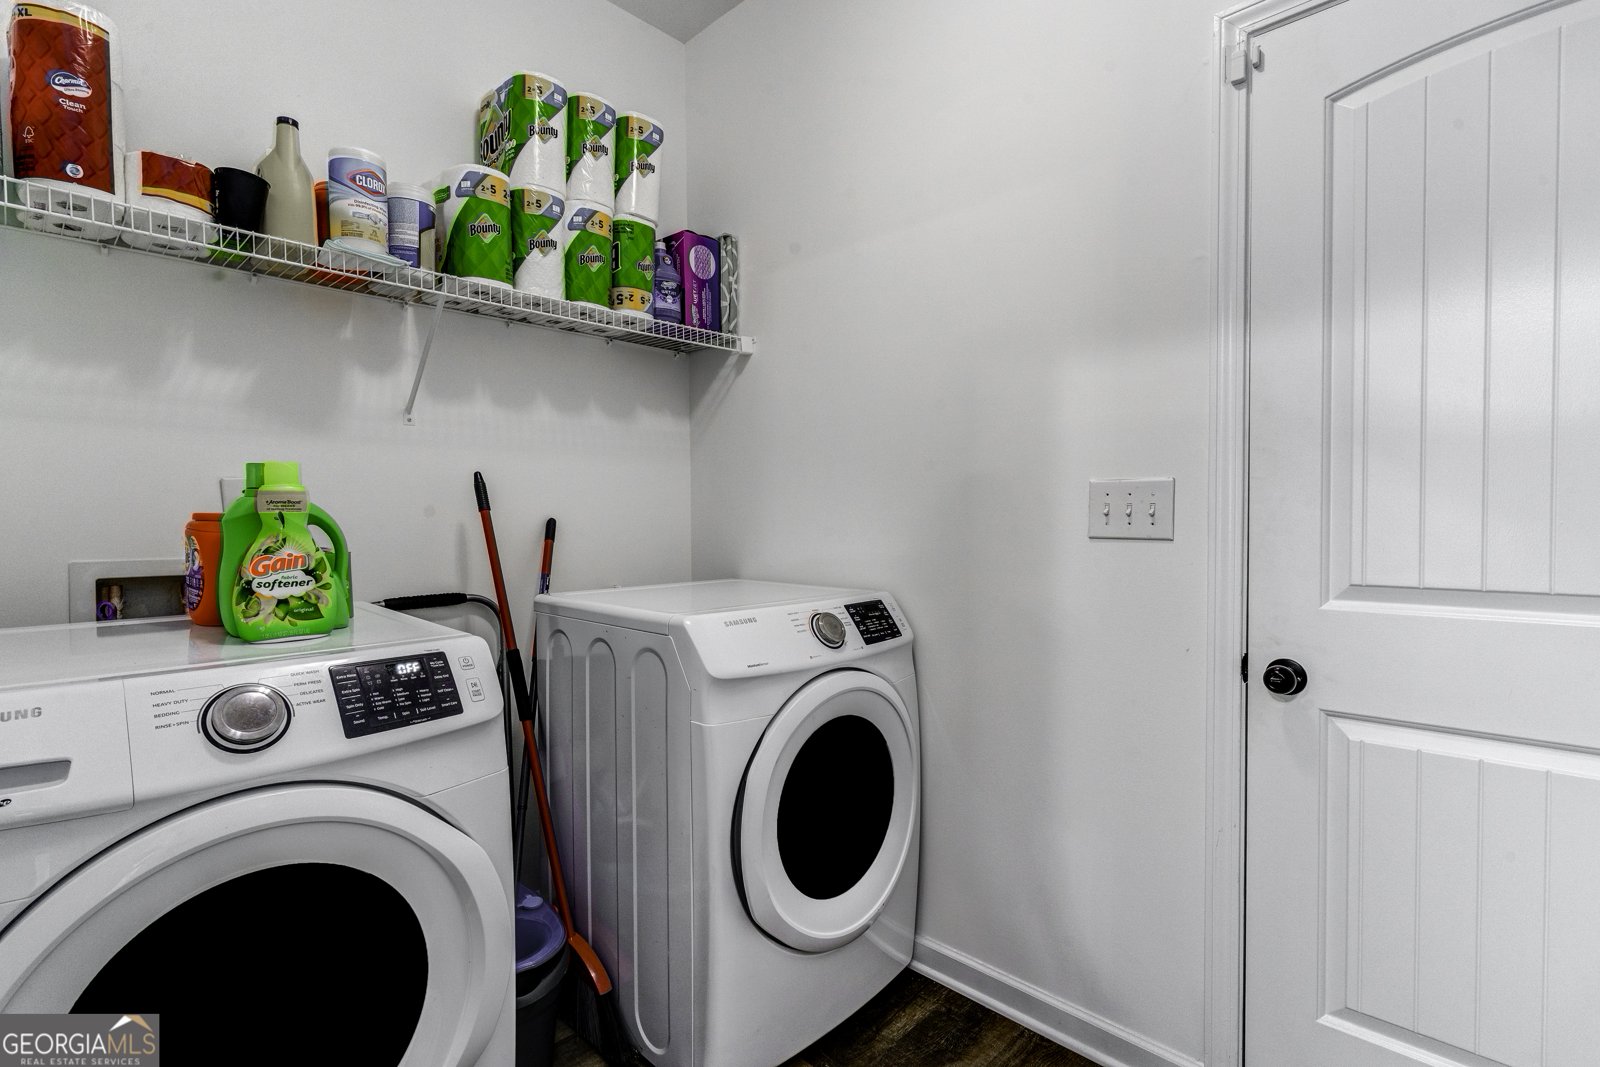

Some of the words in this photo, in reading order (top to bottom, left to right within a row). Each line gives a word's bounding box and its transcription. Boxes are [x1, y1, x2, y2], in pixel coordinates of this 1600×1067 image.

[17, 7, 33, 17] XL
[59, 98, 86, 110] Clean
[63, 104, 84, 114] Touch
[529, 124, 559, 139] Bounty
[582, 143, 609, 156] Bounty
[630, 161, 656, 174] Bounty
[469, 223, 501, 237] Bounty
[529, 238, 558, 251] Bounty
[579, 254, 606, 266] Bounty
[250, 552, 308, 577] Gain
[256, 578, 314, 592] softener
[724, 617, 758, 628] SAMSUNG
[396, 662, 420, 674] OFF
